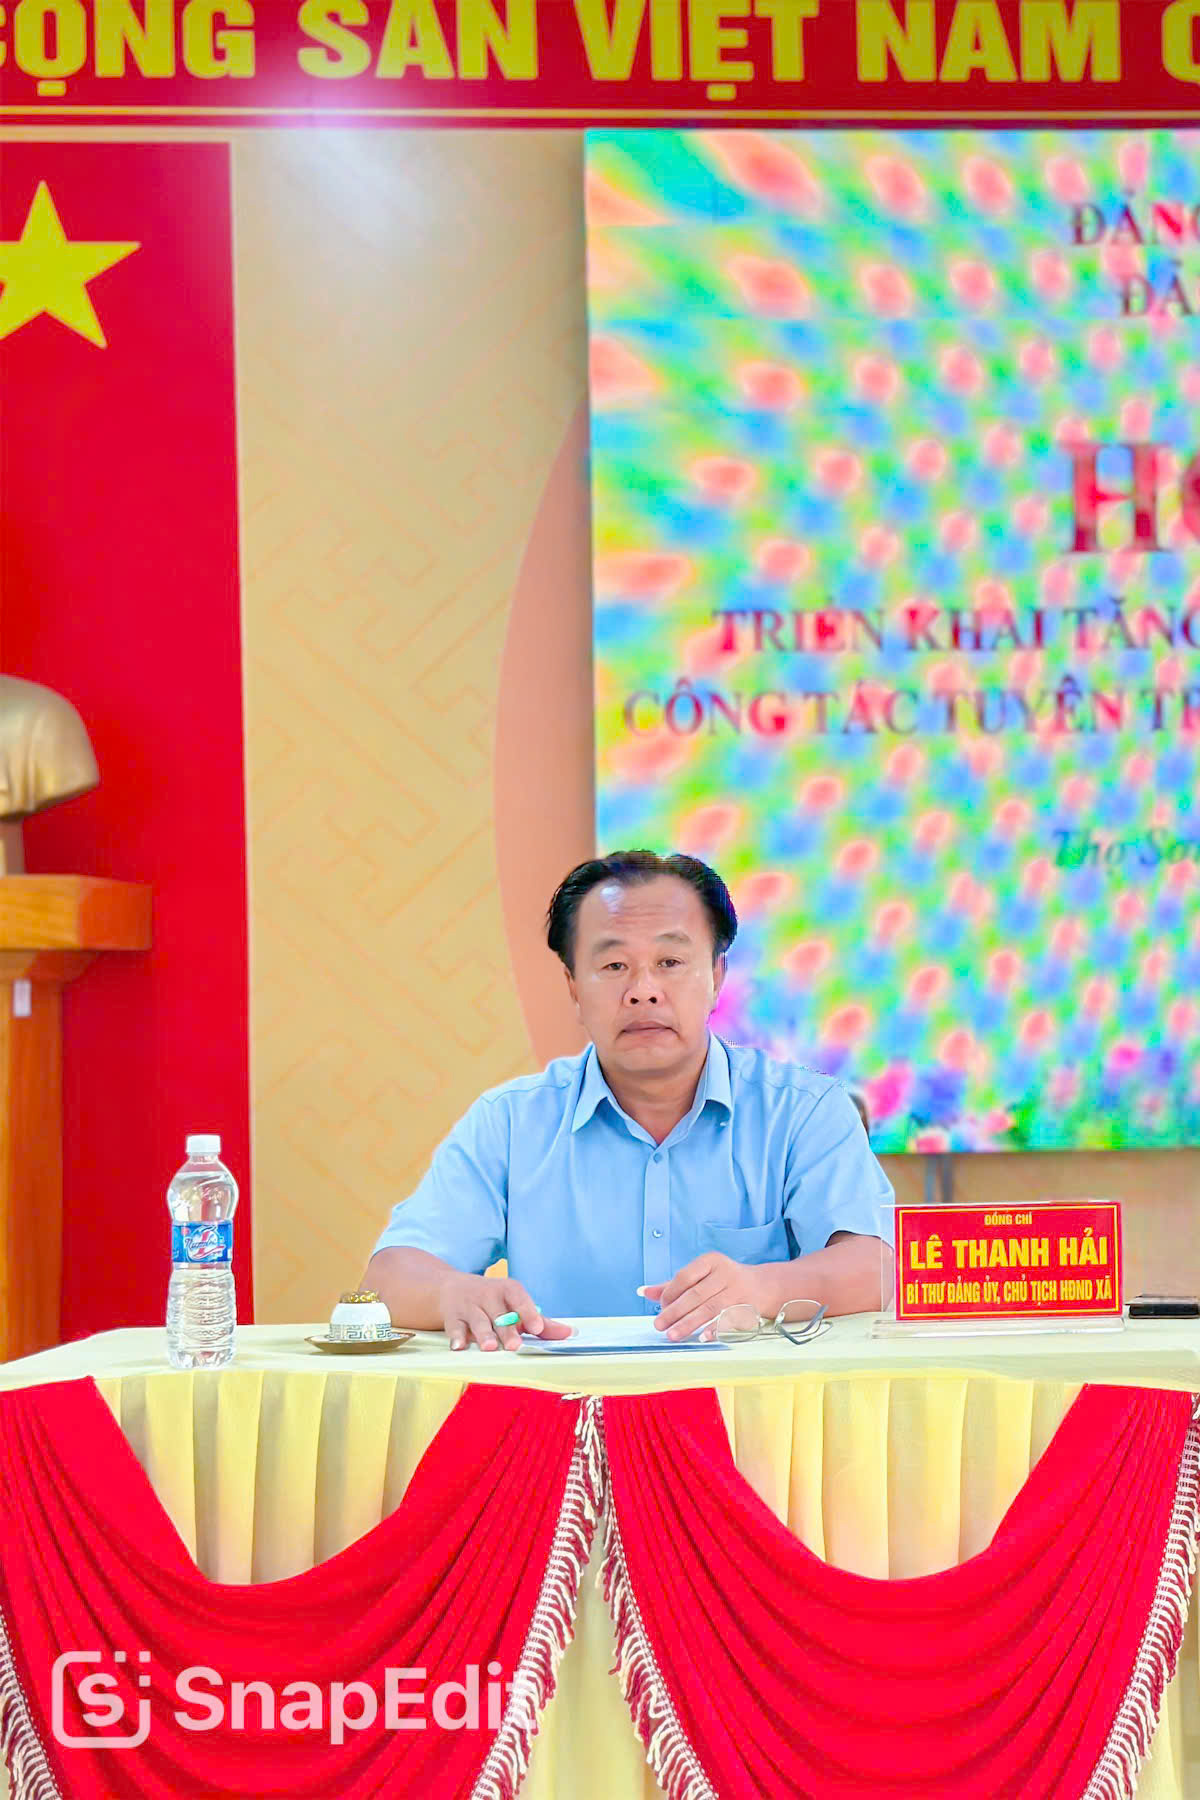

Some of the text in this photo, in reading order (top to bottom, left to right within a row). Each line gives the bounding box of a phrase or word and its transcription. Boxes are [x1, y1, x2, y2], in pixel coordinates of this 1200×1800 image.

[857, 0, 1122, 82] NAM
[902, 605, 1046, 651] KHAI
[622, 676, 789, 736] CÔNG
[932, 674, 1124, 734] TUYÊN
[909, 1227, 1108, 1270] LÊ THANH HẢI
[906, 1274, 1113, 1306] BÍ THƯ ĐẢNG ỦY, CHỦ TỊCH HĐND XÃ
